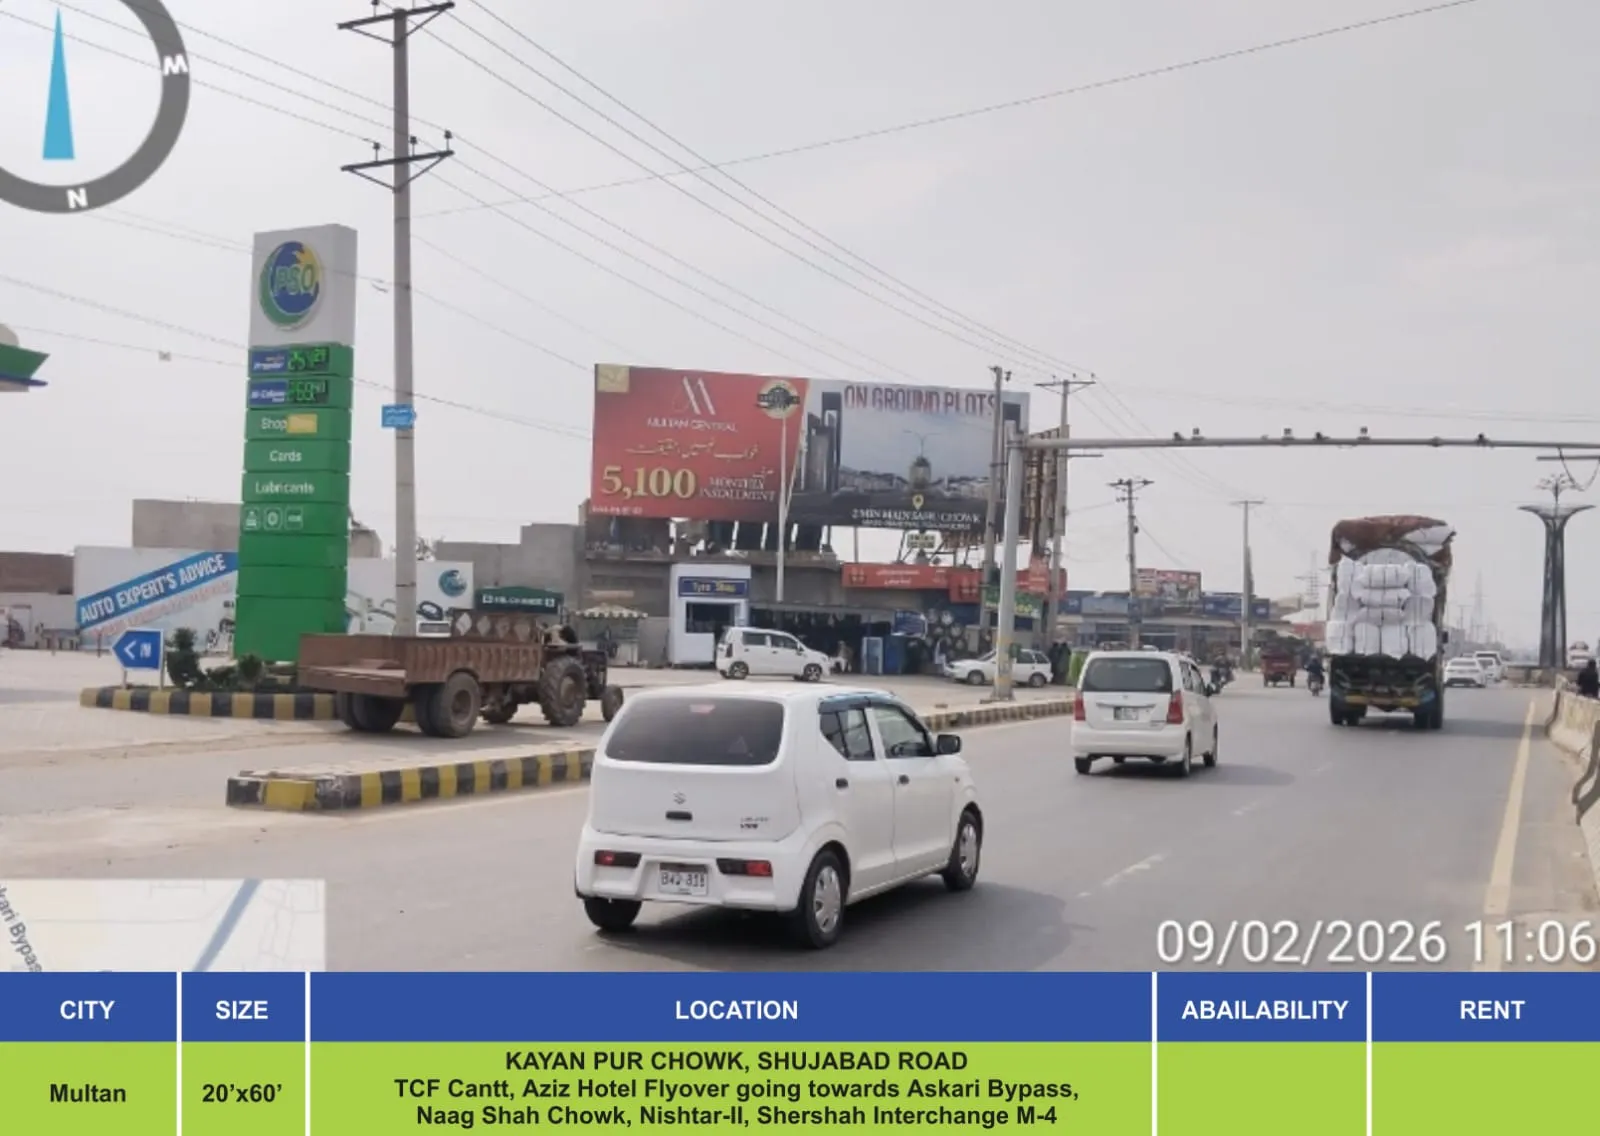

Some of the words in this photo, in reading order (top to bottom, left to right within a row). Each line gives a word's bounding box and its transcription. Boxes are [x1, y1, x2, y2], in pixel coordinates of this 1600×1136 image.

[843, 385, 868, 409] ON
[871, 386, 941, 414] GROUND
[261, 417, 287, 431] Shop
[691, 420, 739, 434] CENTRAL
[269, 450, 303, 463] Cards
[255, 481, 315, 495] Lubricants
[602, 466, 697, 500] 5,100
[708, 476, 766, 490] MONTHLY
[700, 487, 776, 502] INSTALLMENT
[80, 595, 115, 624] AUTO
[115, 572, 179, 610] EXPERT'S
[178, 553, 227, 586] ADVICE
